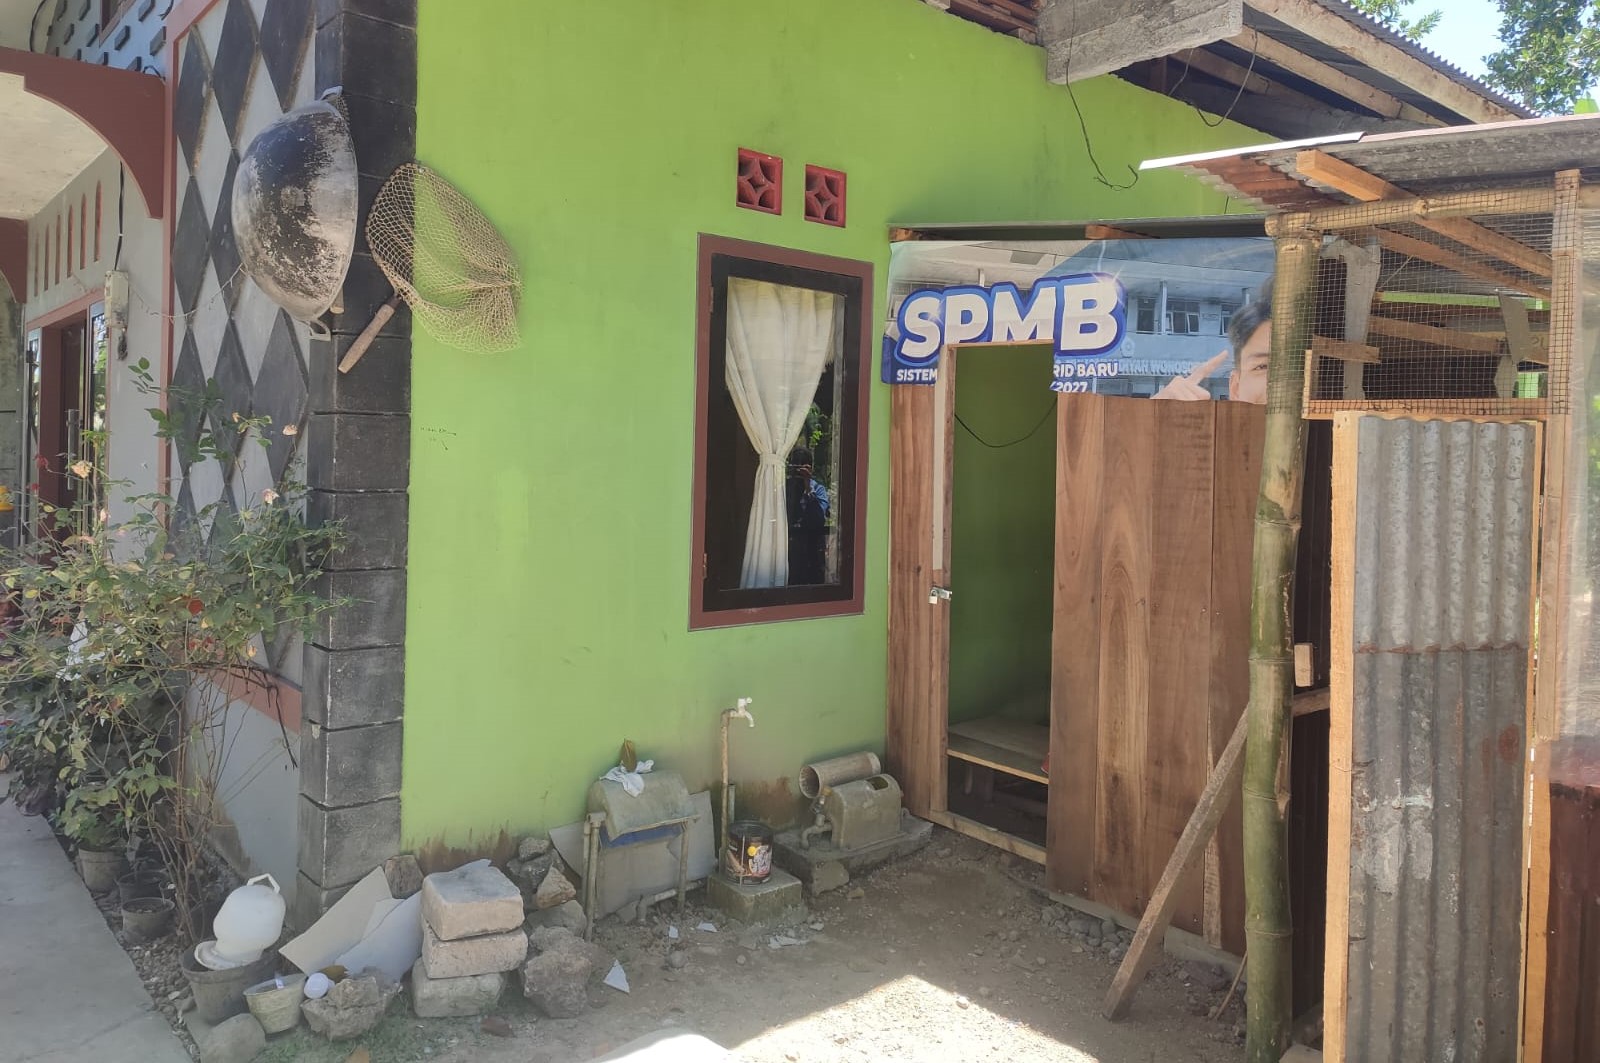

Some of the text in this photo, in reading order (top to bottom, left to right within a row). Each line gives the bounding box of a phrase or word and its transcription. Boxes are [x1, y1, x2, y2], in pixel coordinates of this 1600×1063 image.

[899, 281, 1119, 358] SPMB
[896, 368, 938, 382] SISTEM
[1077, 361, 1119, 378] BARU
